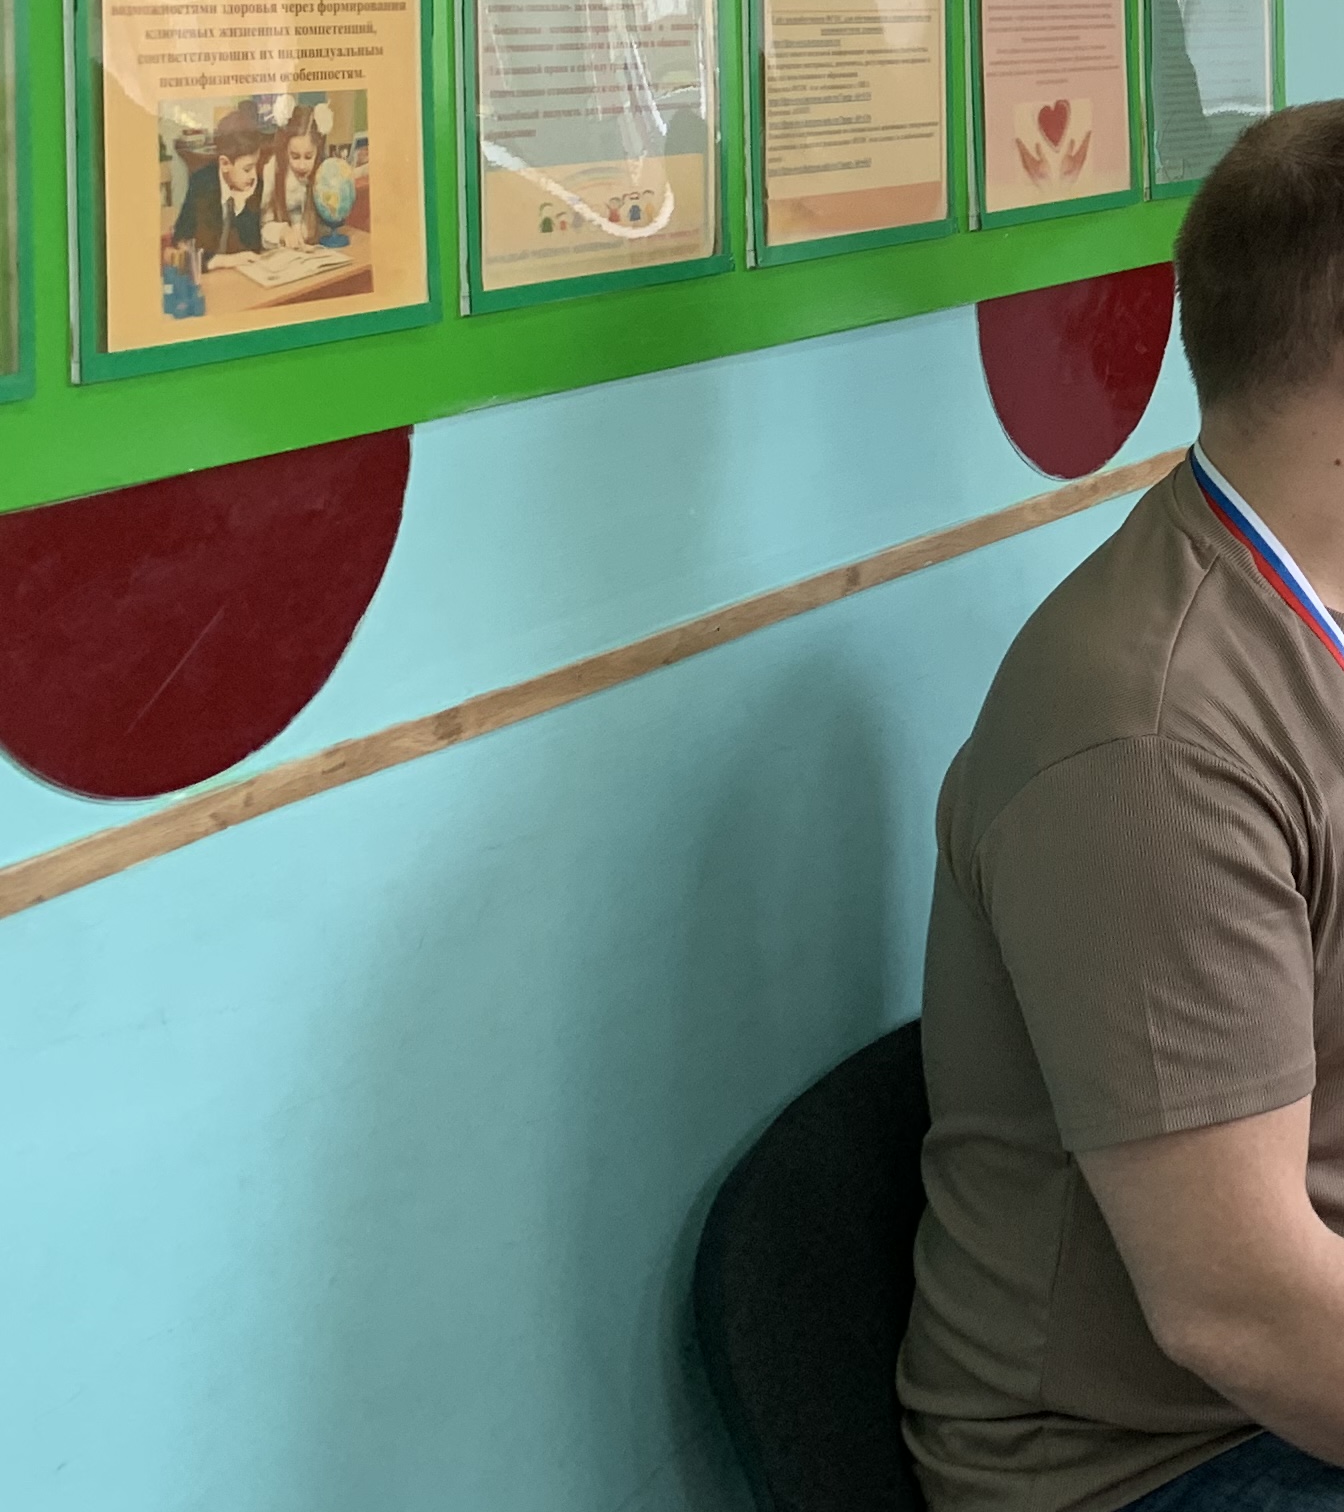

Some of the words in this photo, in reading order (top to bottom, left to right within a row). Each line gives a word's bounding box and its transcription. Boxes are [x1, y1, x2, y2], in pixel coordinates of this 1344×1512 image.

[222, 0, 277, 18] здоровья
[281, 2, 315, 16] через
[317, 0, 406, 17] формирования
[218, 26, 290, 39] жизненных
[294, 21, 377, 37] компетенций,
[260, 48, 274, 60] их
[278, 44, 384, 62] индивидуальным
[159, 71, 276, 90] психофизическим
[280, 67, 366, 83] особенностям.
